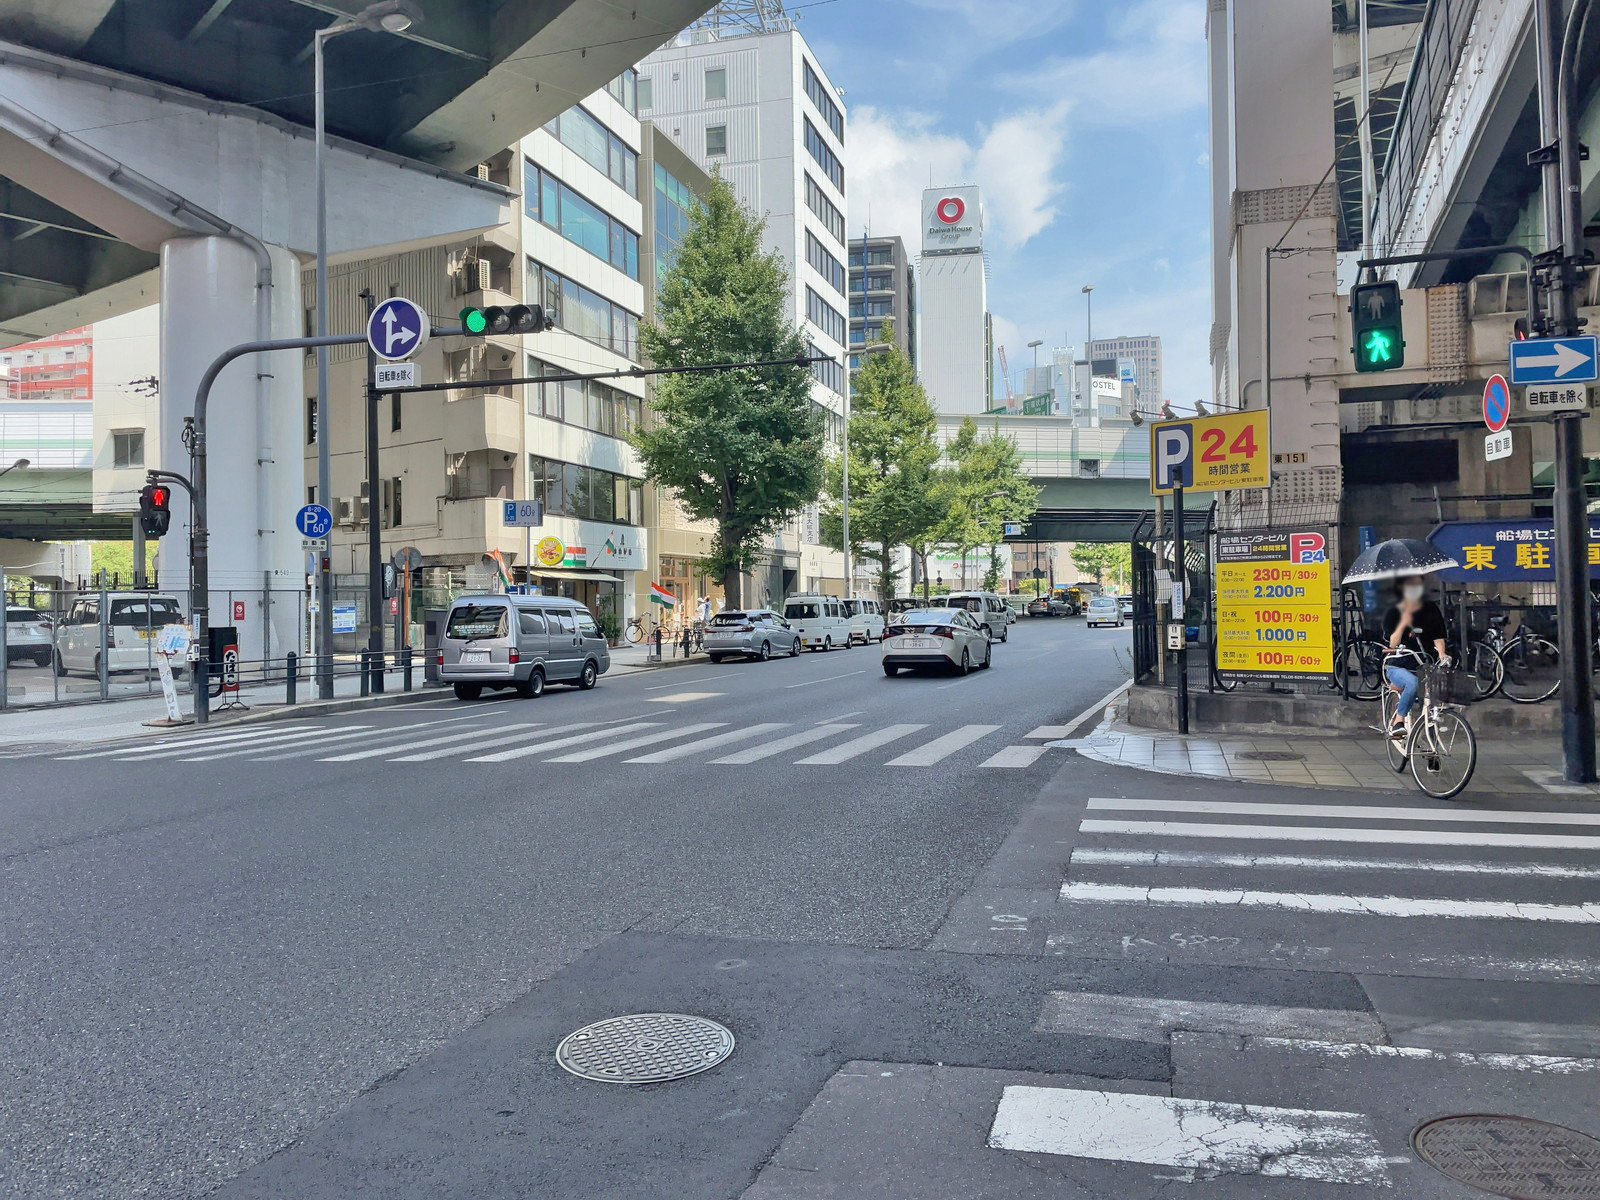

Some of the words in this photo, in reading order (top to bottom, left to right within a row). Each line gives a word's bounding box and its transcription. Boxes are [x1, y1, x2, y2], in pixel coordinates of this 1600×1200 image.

[379, 370, 411, 382] 自転車を除く
[1092, 380, 1116, 391] OSTEL
[1530, 390, 1583, 405] 自転車を除く
[1200, 424, 1258, 463] 24
[1158, 428, 1190, 485] P
[1208, 463, 1251, 476] 時間営業
[507, 503, 514, 515] P
[304, 511, 319, 533] P
[1220, 534, 1287, 545] 船場センタービル
[1252, 544, 1288, 552] 24時間営業
[1253, 584, 1305, 598] 2,200円
[1255, 628, 1307, 641] 1,000円
[225, 650, 236, 686] たばこ
